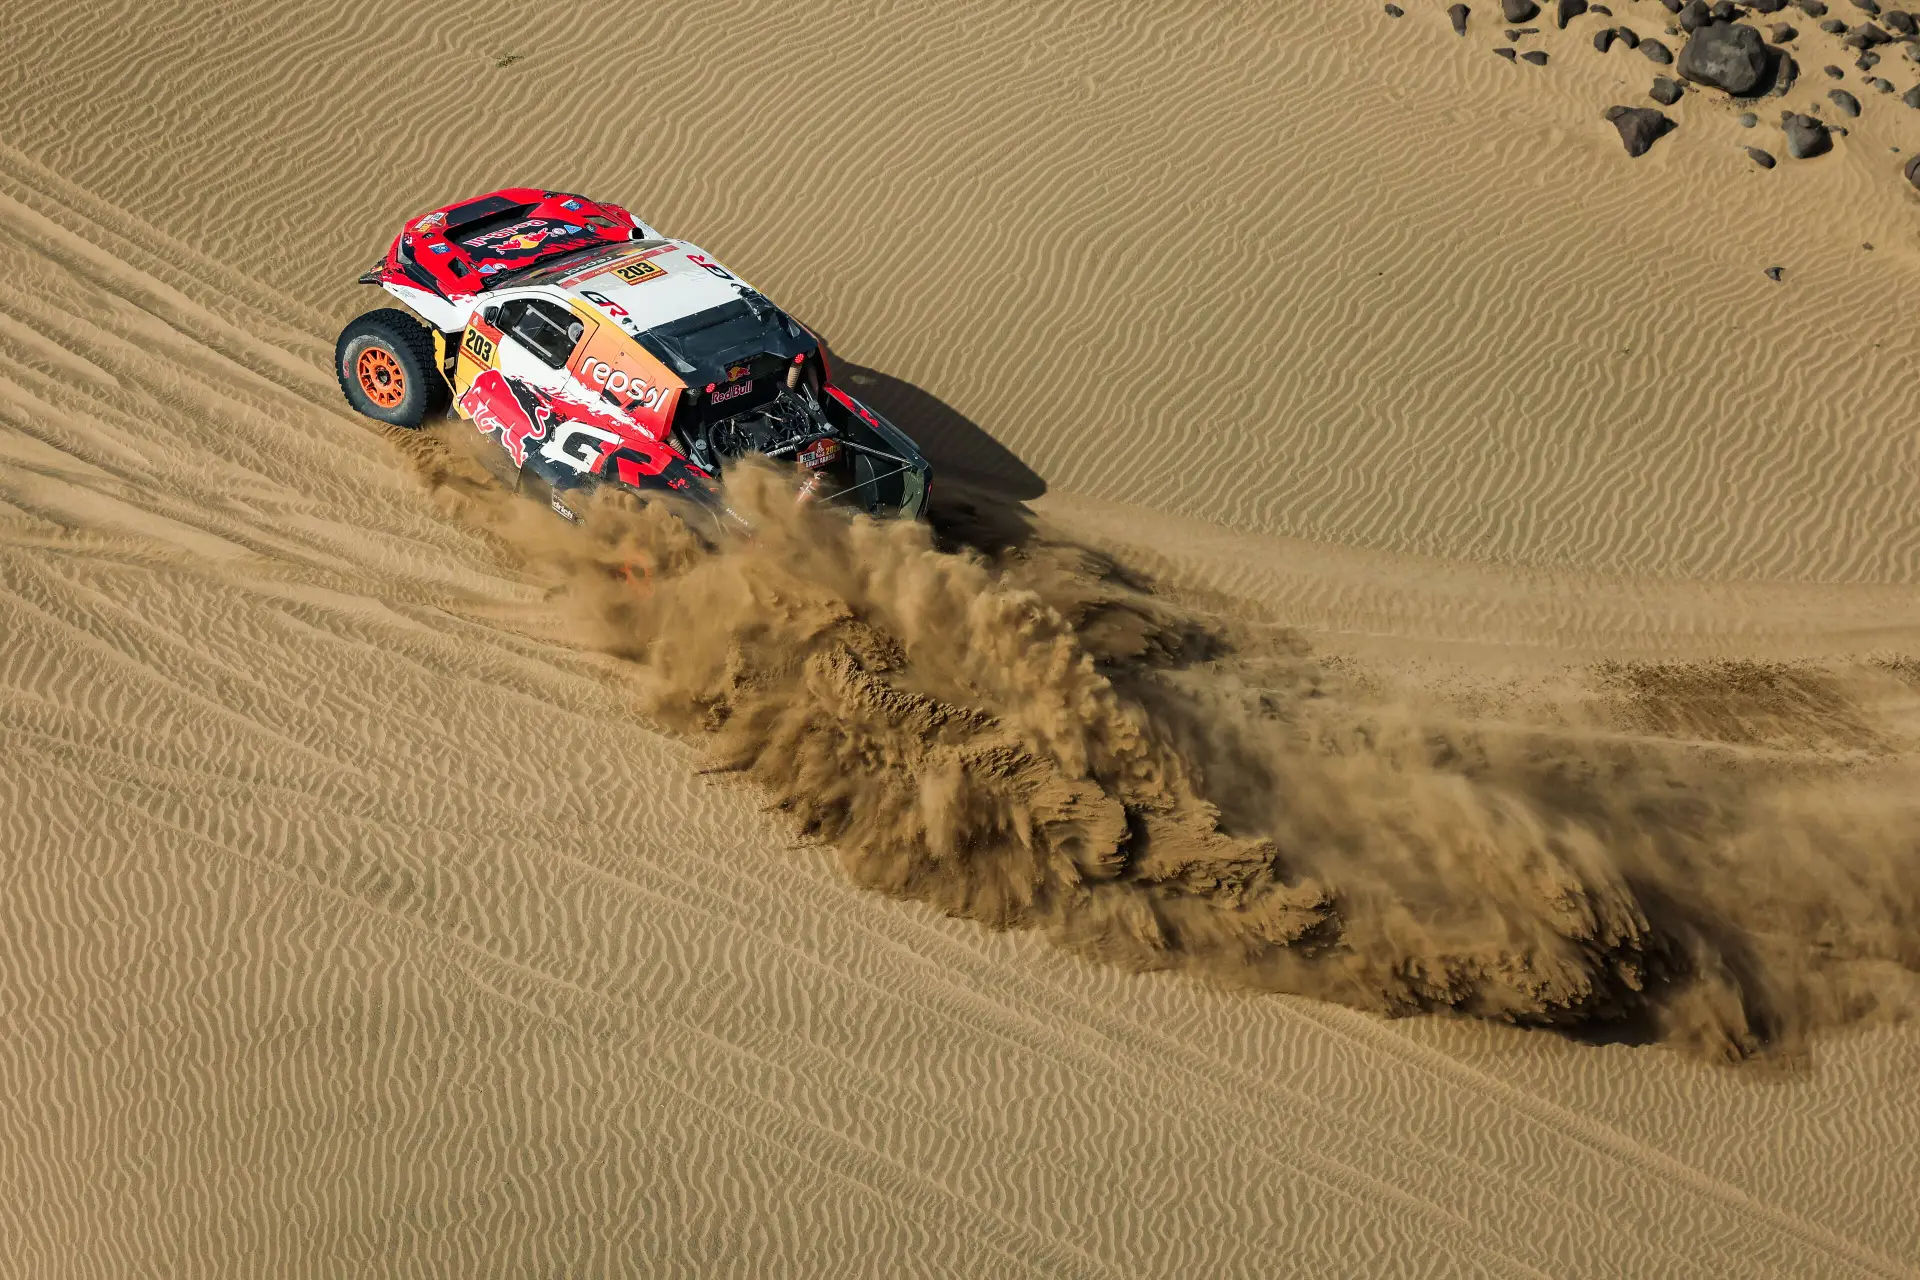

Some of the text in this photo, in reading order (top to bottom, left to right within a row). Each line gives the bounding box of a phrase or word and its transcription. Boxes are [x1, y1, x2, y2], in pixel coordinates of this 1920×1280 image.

[617, 262, 656, 280] 203
[580, 290, 630, 317] GR
[465, 328, 493, 363] 203
[581, 355, 669, 412] repsol
[711, 379, 753, 405] Red Bull
[725, 507, 750, 527] HILUX
